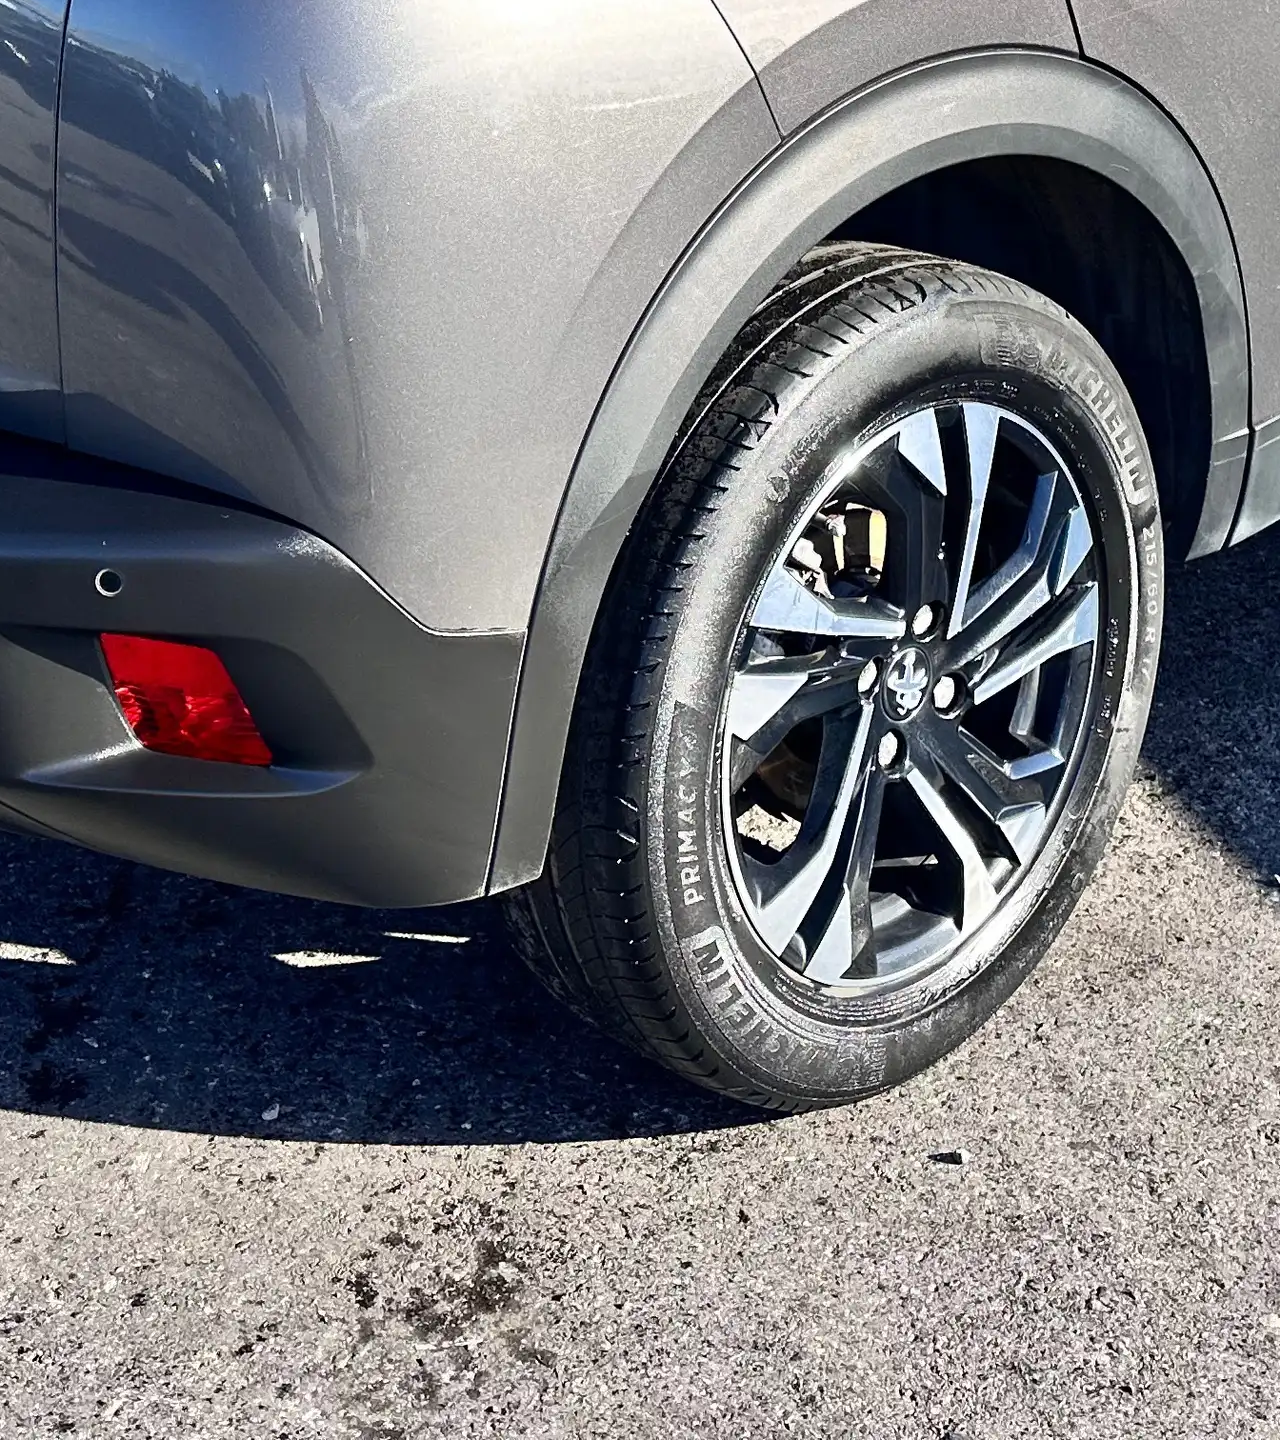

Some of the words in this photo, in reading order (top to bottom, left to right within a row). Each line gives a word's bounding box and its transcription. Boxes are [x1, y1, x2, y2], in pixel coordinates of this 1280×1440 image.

[1044, 348, 1149, 493] MICHELIN
[1140, 526, 1158, 616] 215/60
[1143, 624, 1157, 645] R
[676, 755, 706, 907] PRIMACY
[691, 940, 819, 1070] MICHELIN
